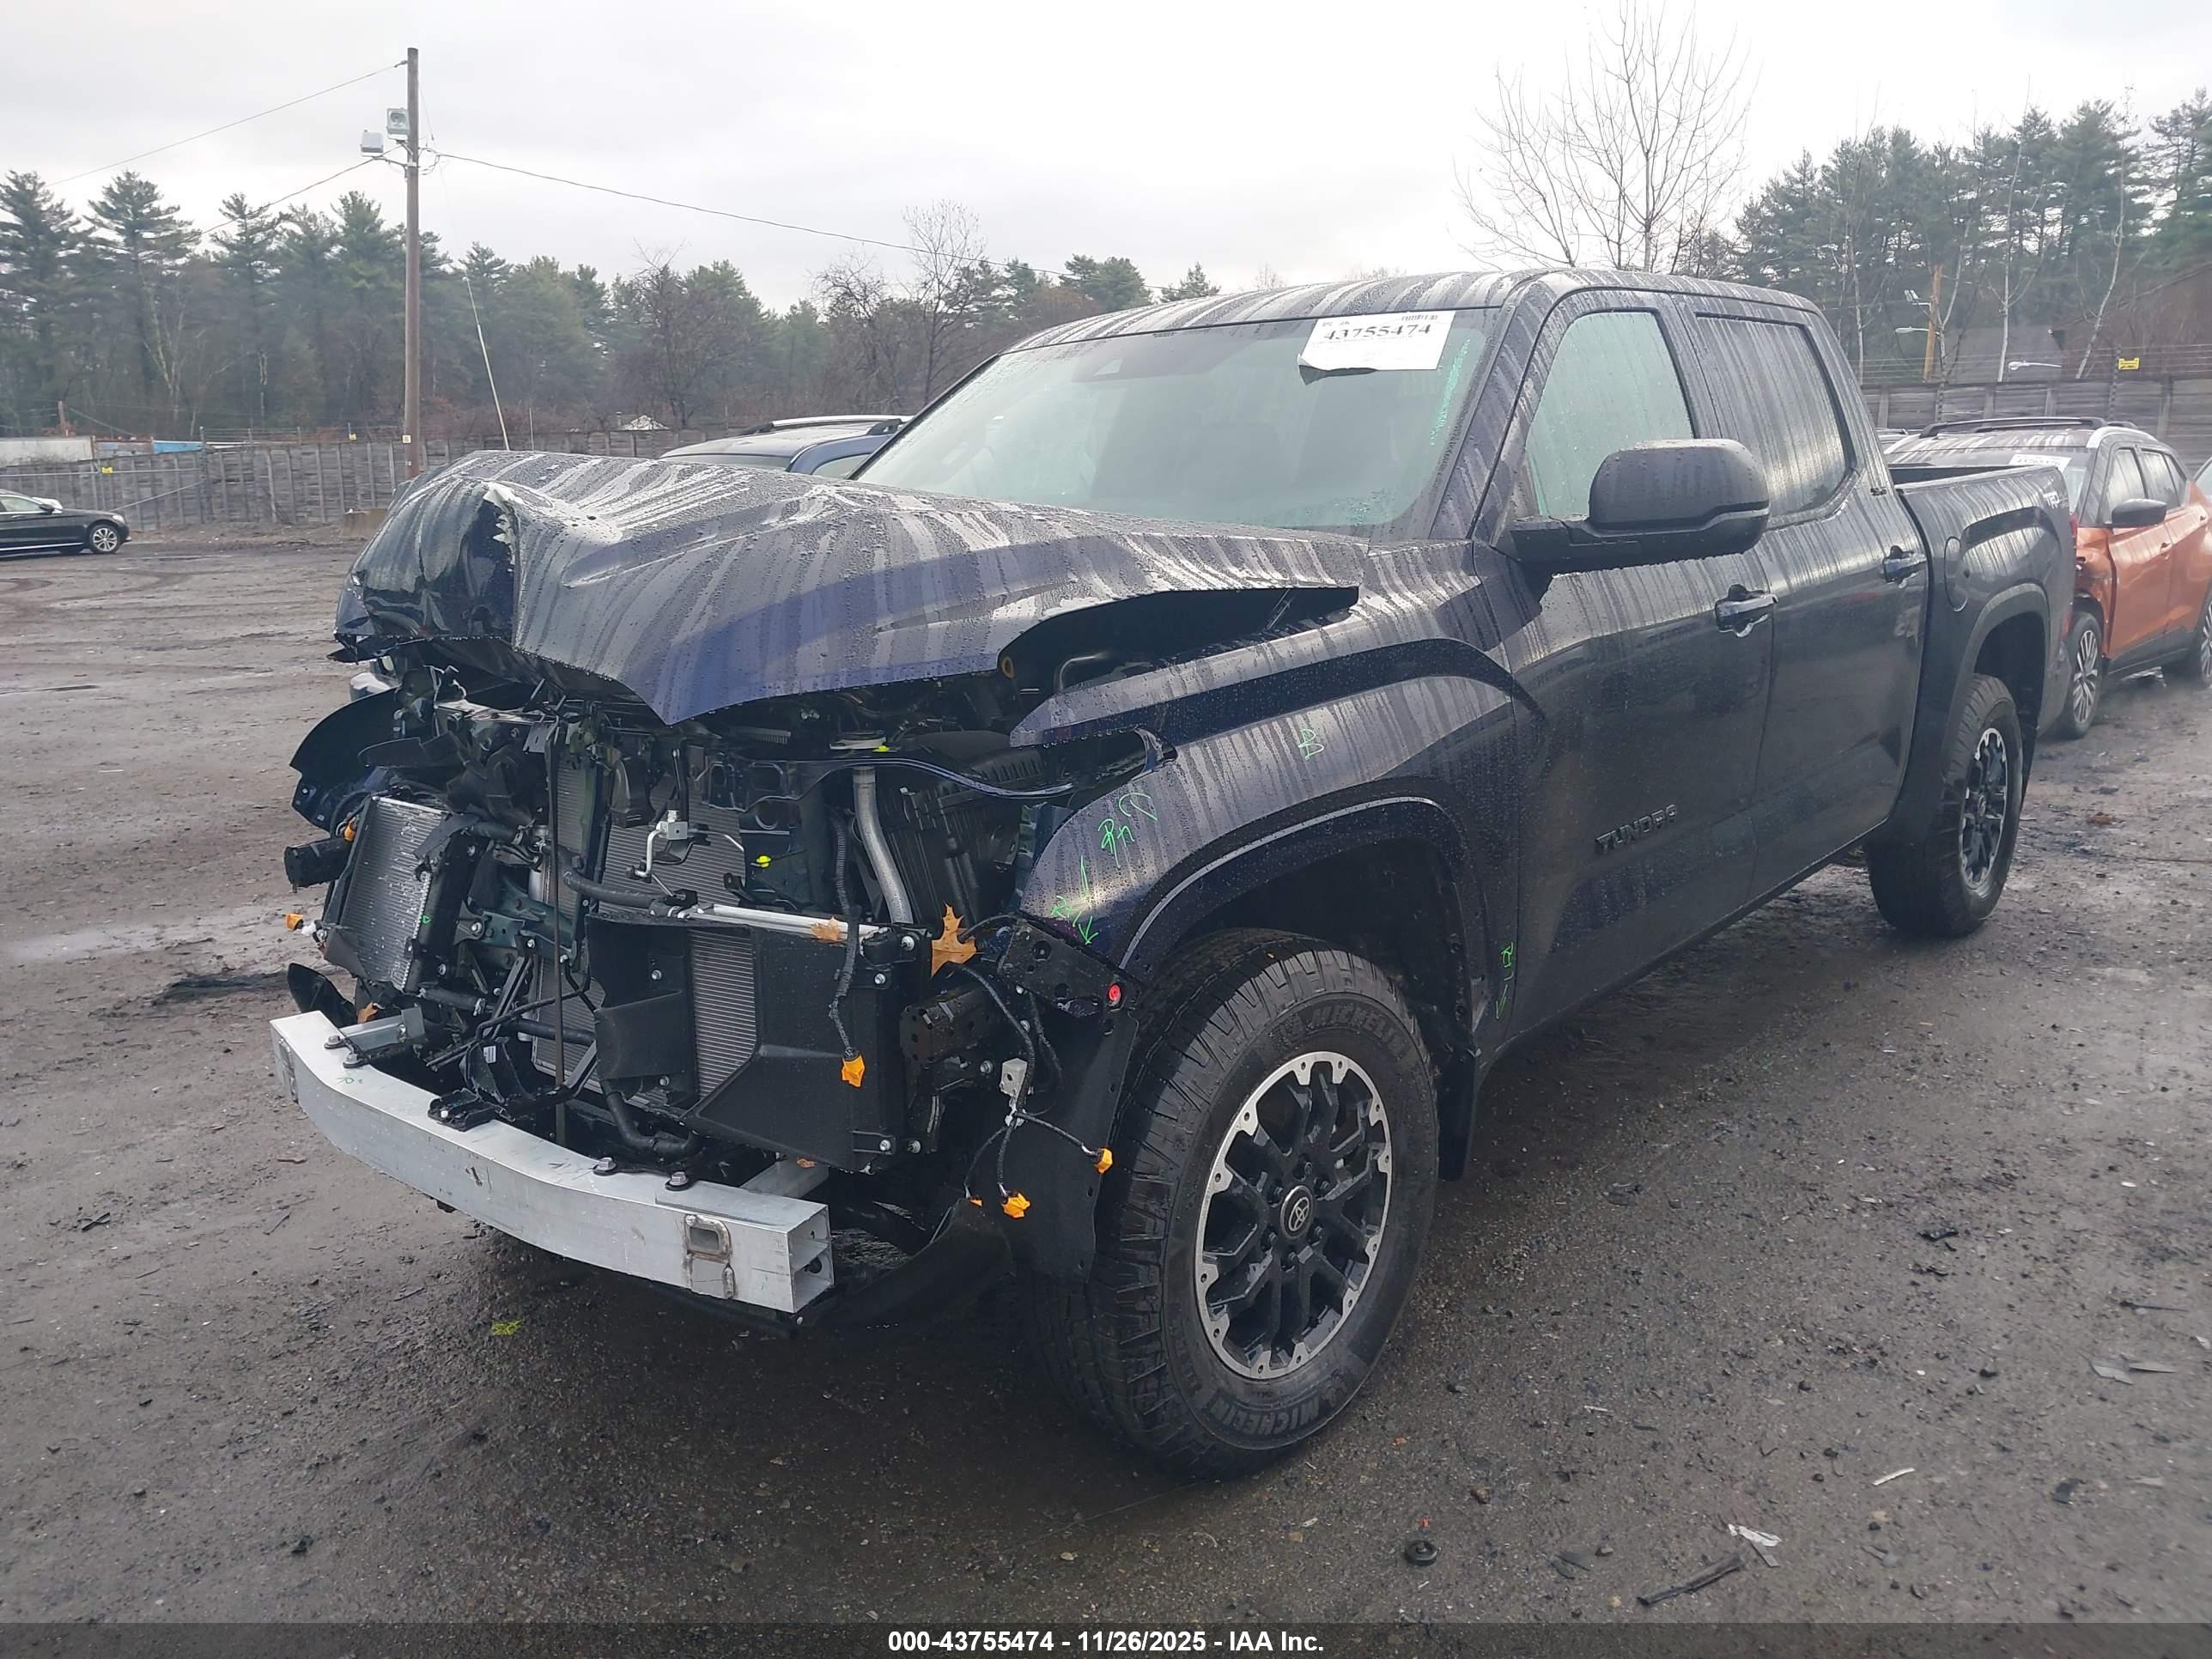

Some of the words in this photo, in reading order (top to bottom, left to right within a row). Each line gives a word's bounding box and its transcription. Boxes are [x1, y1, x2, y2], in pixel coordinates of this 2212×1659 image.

[1323, 324, 1431, 341] 43755474
[1595, 804, 1676, 854] TUNDRA
[1208, 1395, 1321, 1436] MICHELIN
